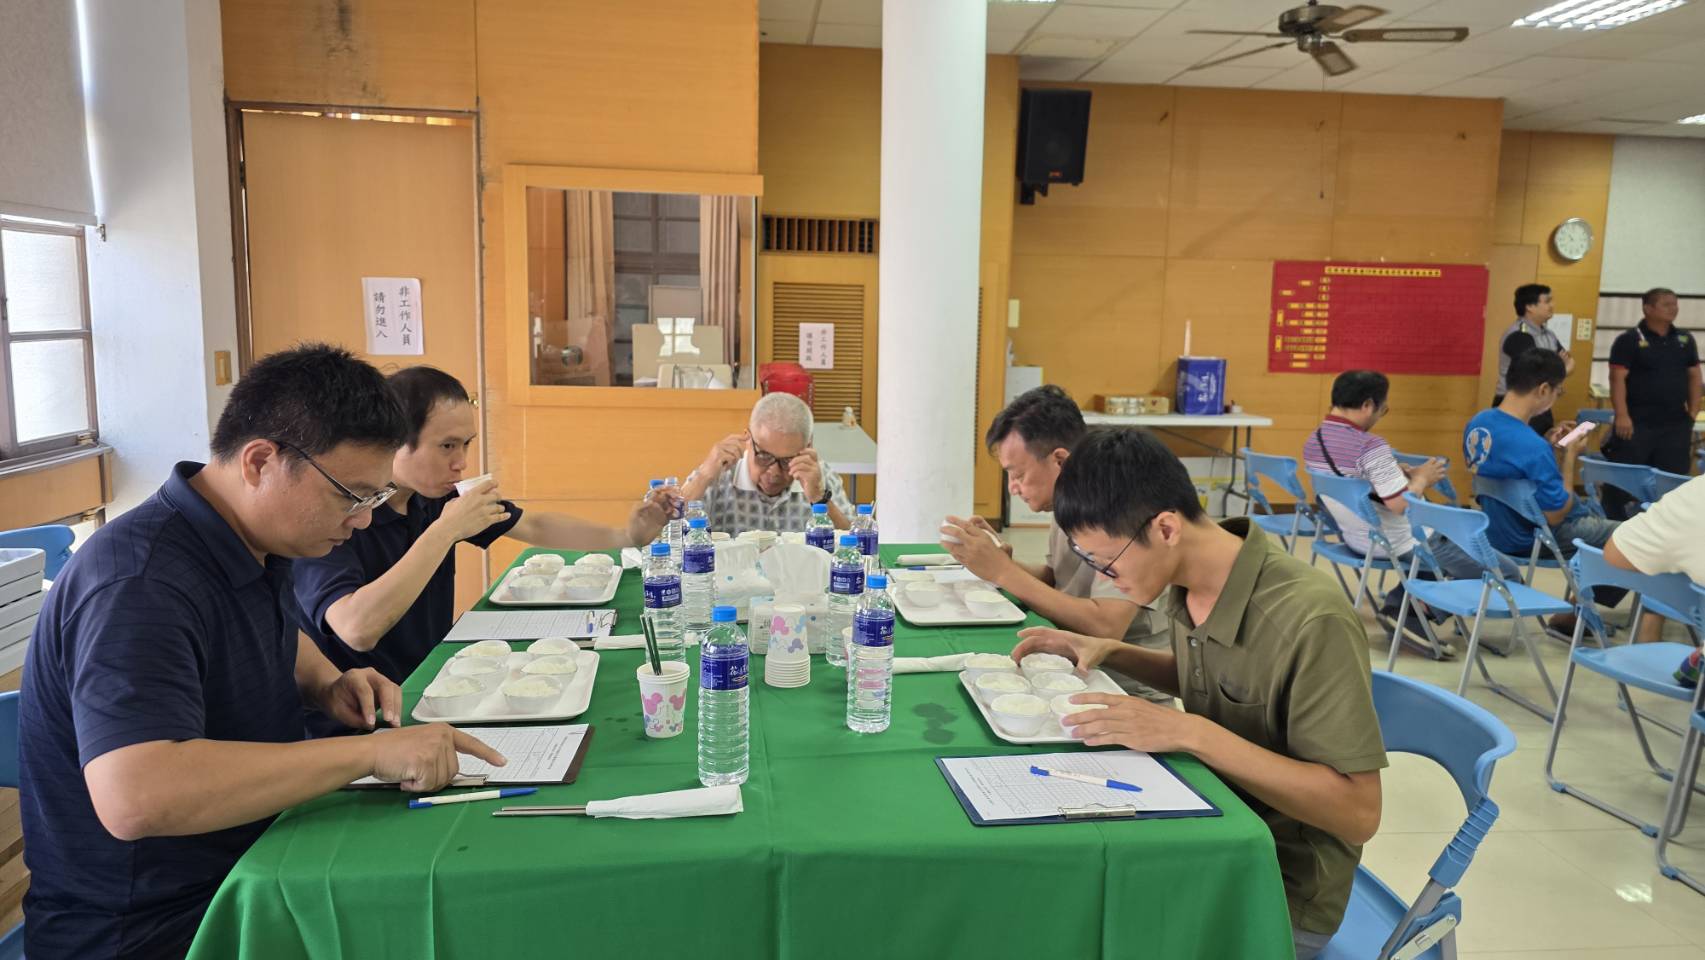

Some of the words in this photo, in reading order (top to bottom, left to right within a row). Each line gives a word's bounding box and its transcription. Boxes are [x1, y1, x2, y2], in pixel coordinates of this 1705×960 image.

[373, 291, 388, 338] 請勿進入
[399, 286, 412, 345] 非工作人員
